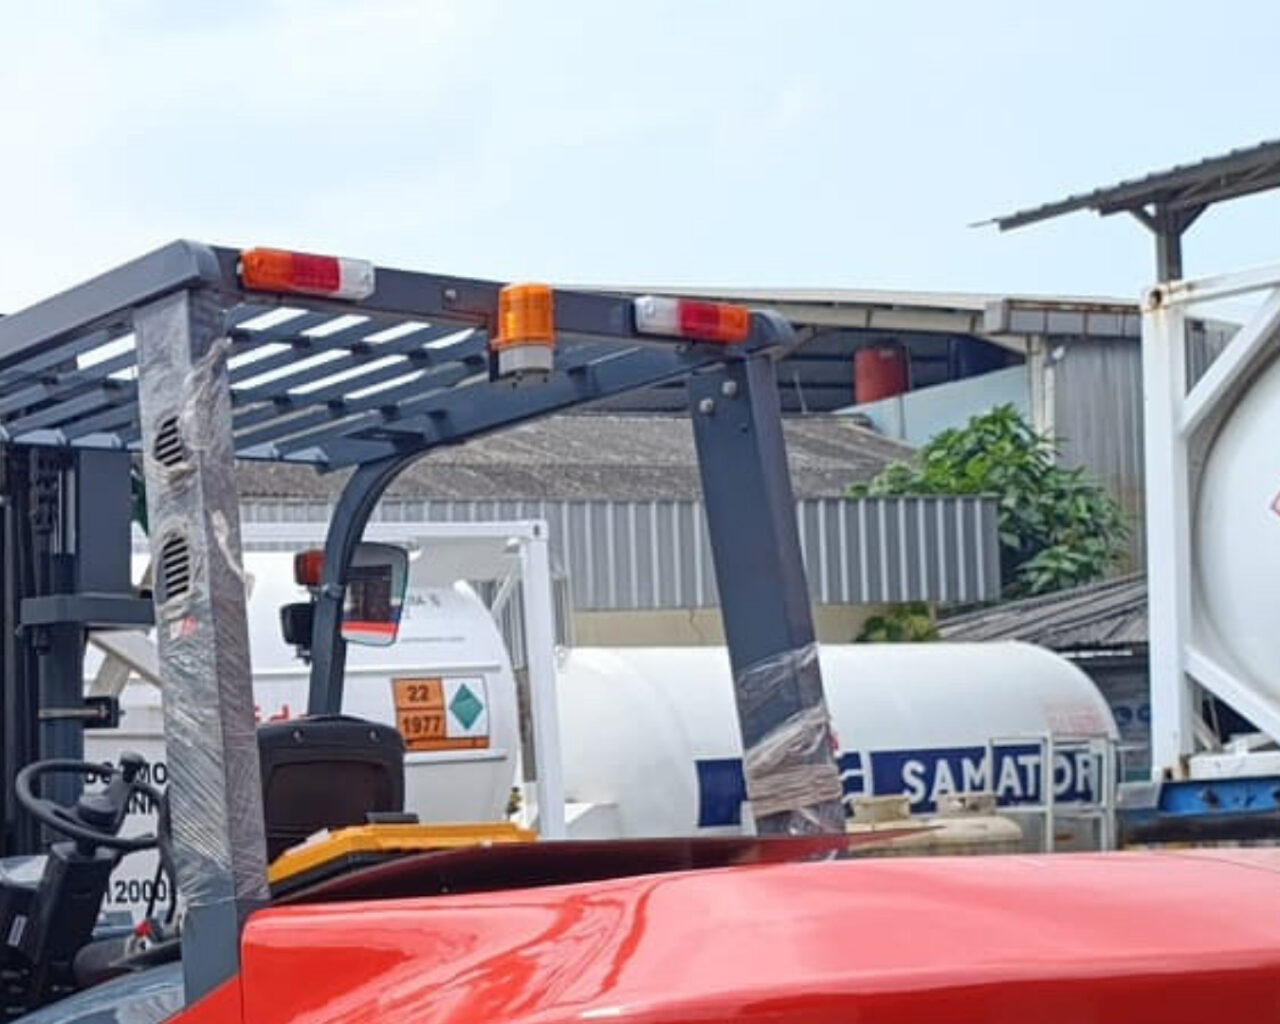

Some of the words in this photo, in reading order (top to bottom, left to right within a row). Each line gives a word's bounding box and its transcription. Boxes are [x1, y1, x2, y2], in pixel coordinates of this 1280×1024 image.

[407, 684, 429, 702] 22
[403, 716, 440, 733] 1977
[902, 754, 1093, 803] SAMATOR
